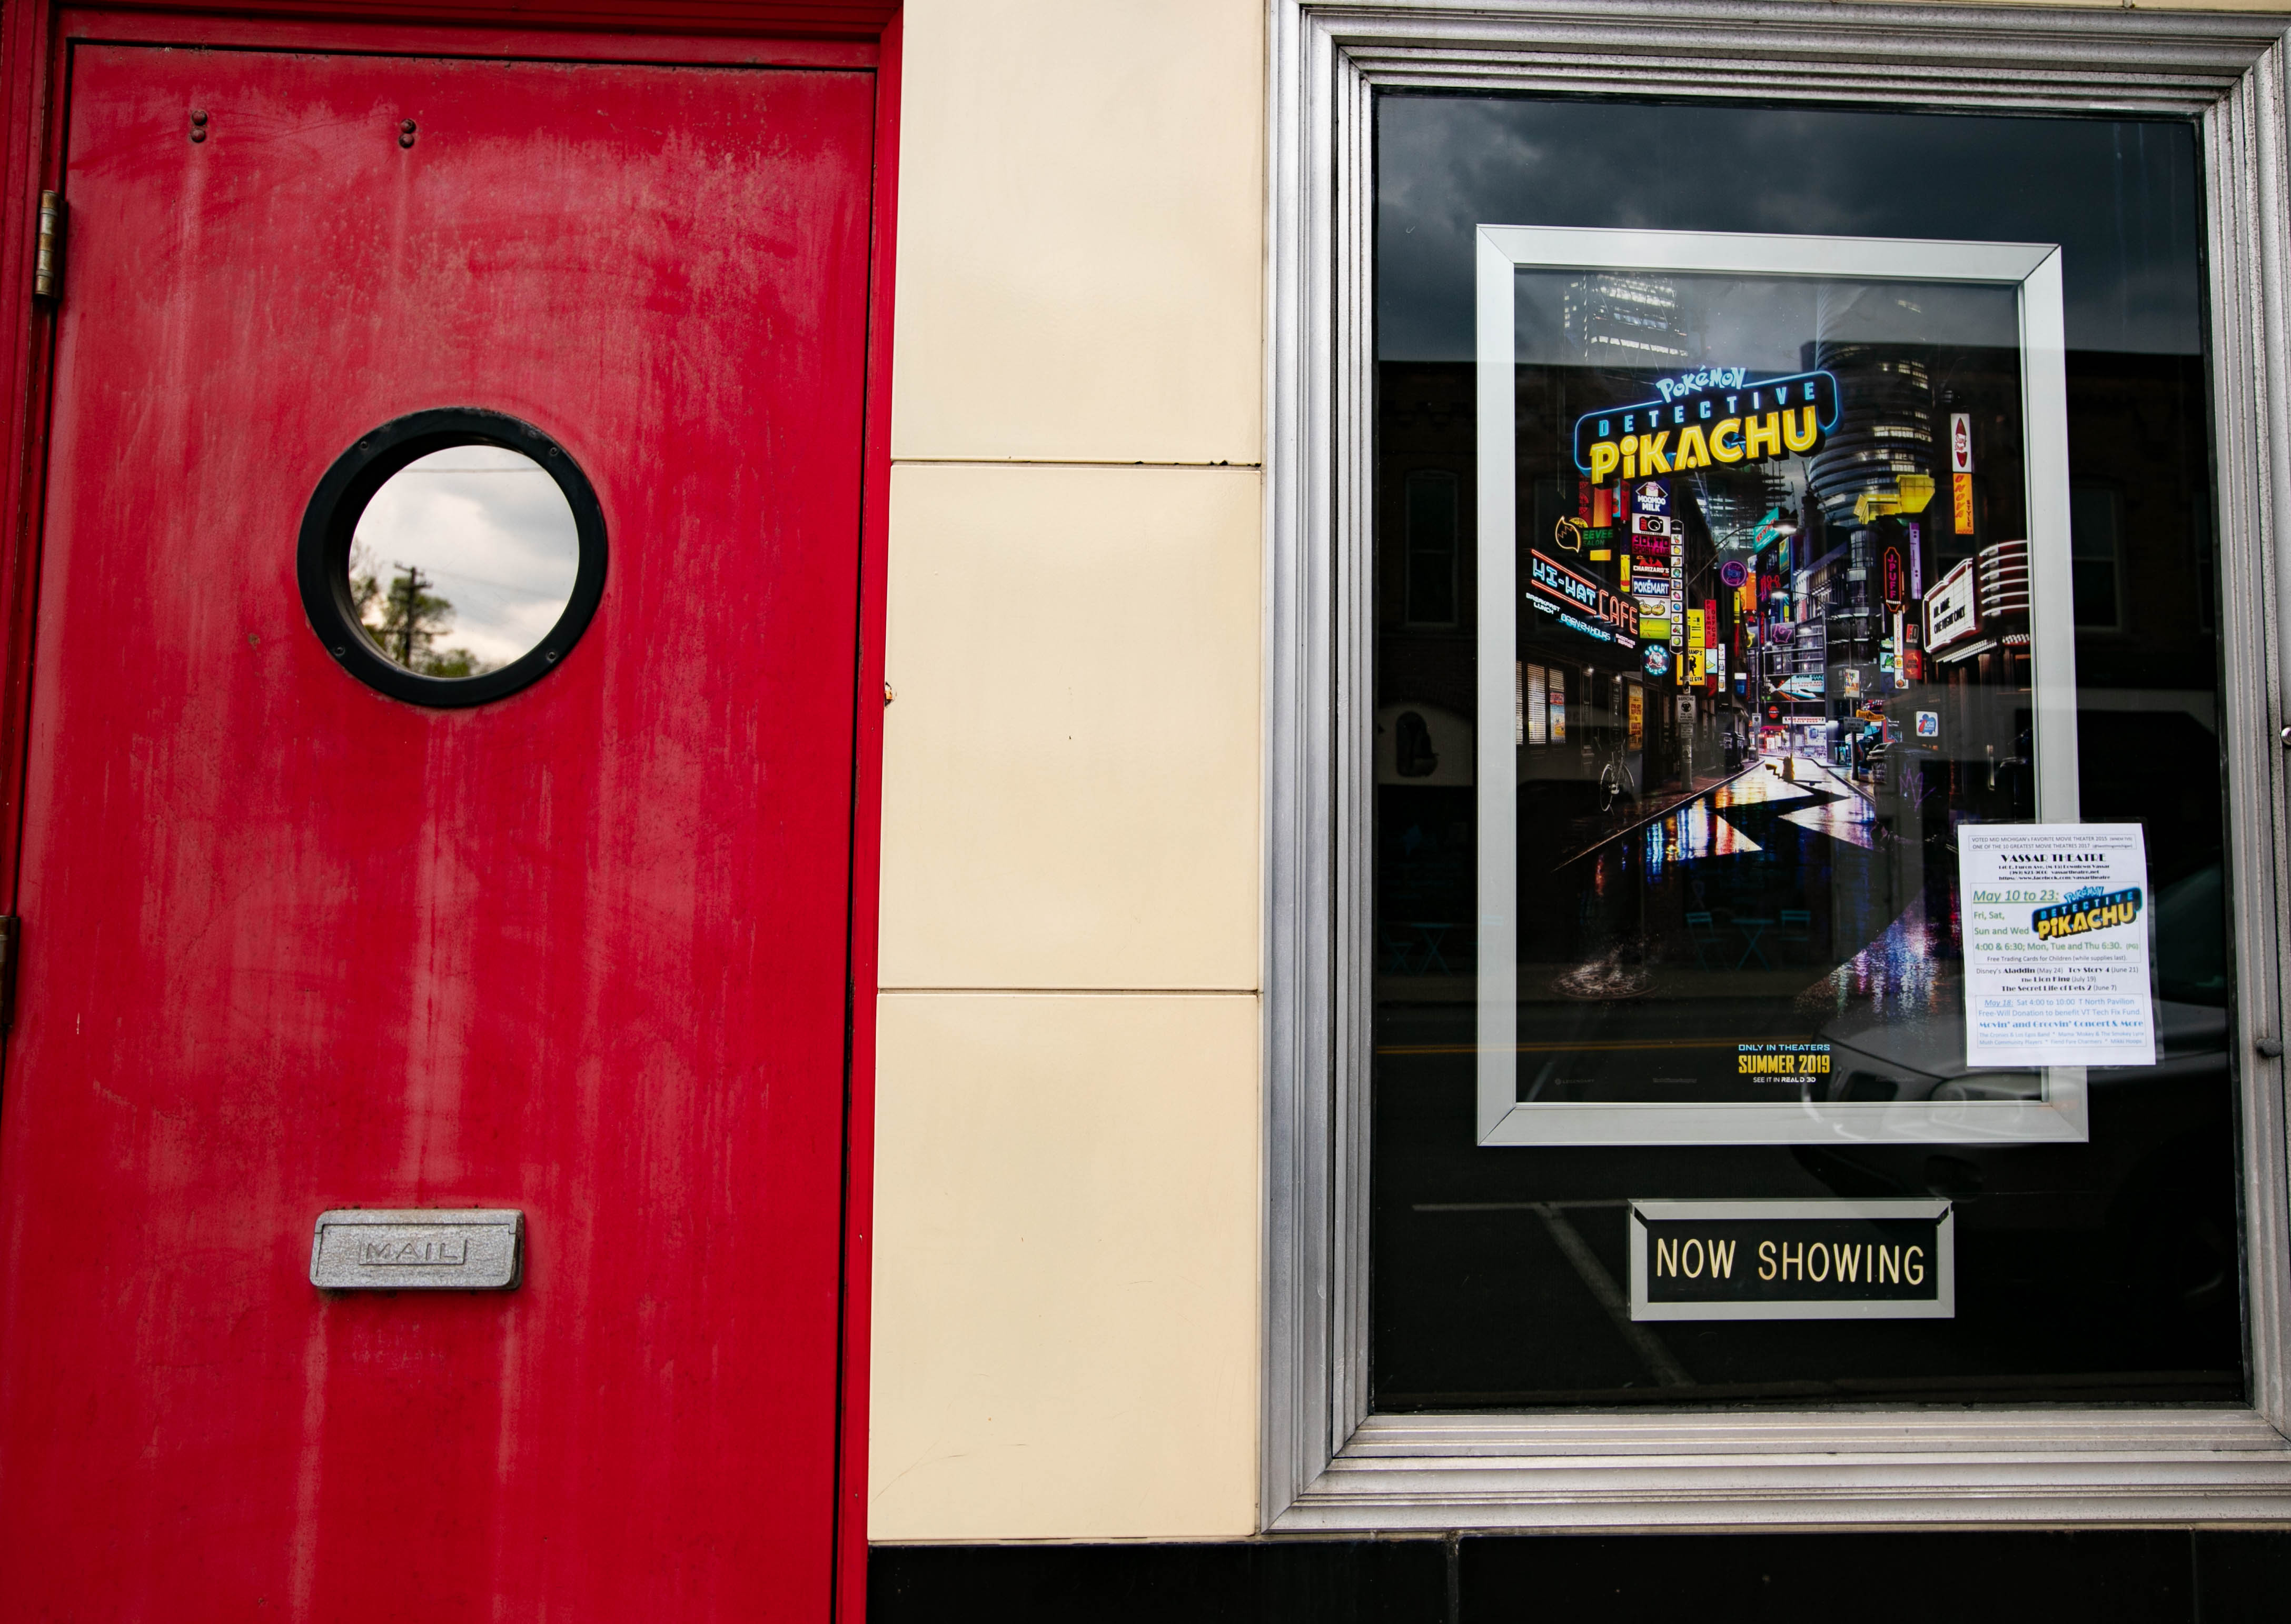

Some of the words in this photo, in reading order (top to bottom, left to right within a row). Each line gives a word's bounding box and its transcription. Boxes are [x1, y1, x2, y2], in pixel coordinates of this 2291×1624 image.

[1599, 382, 1816, 437] DETECTIVE
[1637, 495, 1666, 505] MOOMOO
[1955, 474, 1965, 518] UNOVA
[1642, 503, 1660, 512] MILK
[1583, 529, 1613, 540] EEVEE
[1655, 547, 1669, 556] CLUB
[1633, 565, 1669, 574] CHARIZARD'S
[1633, 580, 1669, 594] POKÉMART
[1526, 593, 1561, 612] BREAKFAST
[1533, 558, 1596, 606] HI-HAT
[1599, 589, 1638, 635] CAFE
[1533, 602, 1554, 614] LUNCH
[1954, 604, 1965, 622] ONLY
[1561, 613, 1580, 628] OPEN
[1590, 625, 1611, 641] HOURS
[2001, 854, 2048, 863] VASSAR
[2052, 853, 2107, 862] THEATRE
[1973, 890, 2001, 903] May
[2005, 890, 2020, 901] 10
[2024, 890, 2036, 901] to
[2040, 890, 2059, 901] 23:
[2040, 891, 2133, 920] DETECTIVE
[1973, 911, 1987, 920] Fri,
[1989, 911, 2005, 920] Sat,
[1992, 926, 2008, 935] and
[2010, 926, 2029, 935] Wed
[2005, 942, 2025, 952] 6:30;
[2027, 942, 2049, 952] Mon,
[2068, 942, 2082, 950] and
[2084, 941, 2099, 950] Thu
[2101, 941, 2122, 950] 6:30.
[1738, 1054, 1794, 1073] SUMMER
[1799, 1054, 1830, 1073] 2019
[365, 1242, 459, 1260] MAIL
[1657, 1238, 1737, 1279] NOW
[1759, 1240, 1925, 1286] SHOWING
